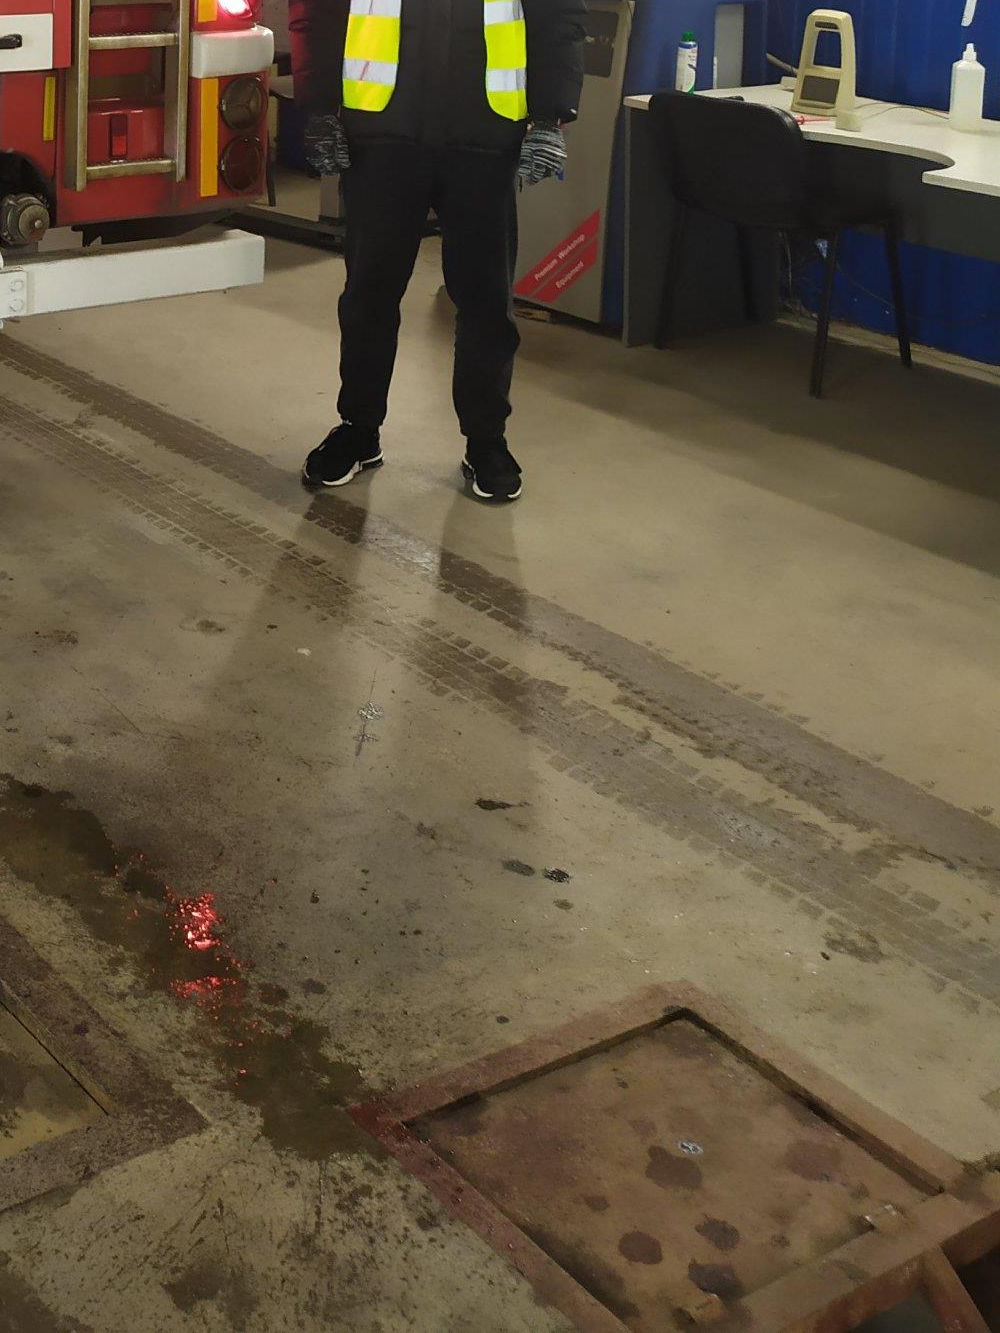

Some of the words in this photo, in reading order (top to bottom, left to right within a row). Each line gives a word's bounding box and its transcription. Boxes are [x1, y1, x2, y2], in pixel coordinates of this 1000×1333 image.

[534, 259, 558, 281] Premium
[557, 234, 585, 259] Workshop
[556, 261, 584, 288] Equipment
